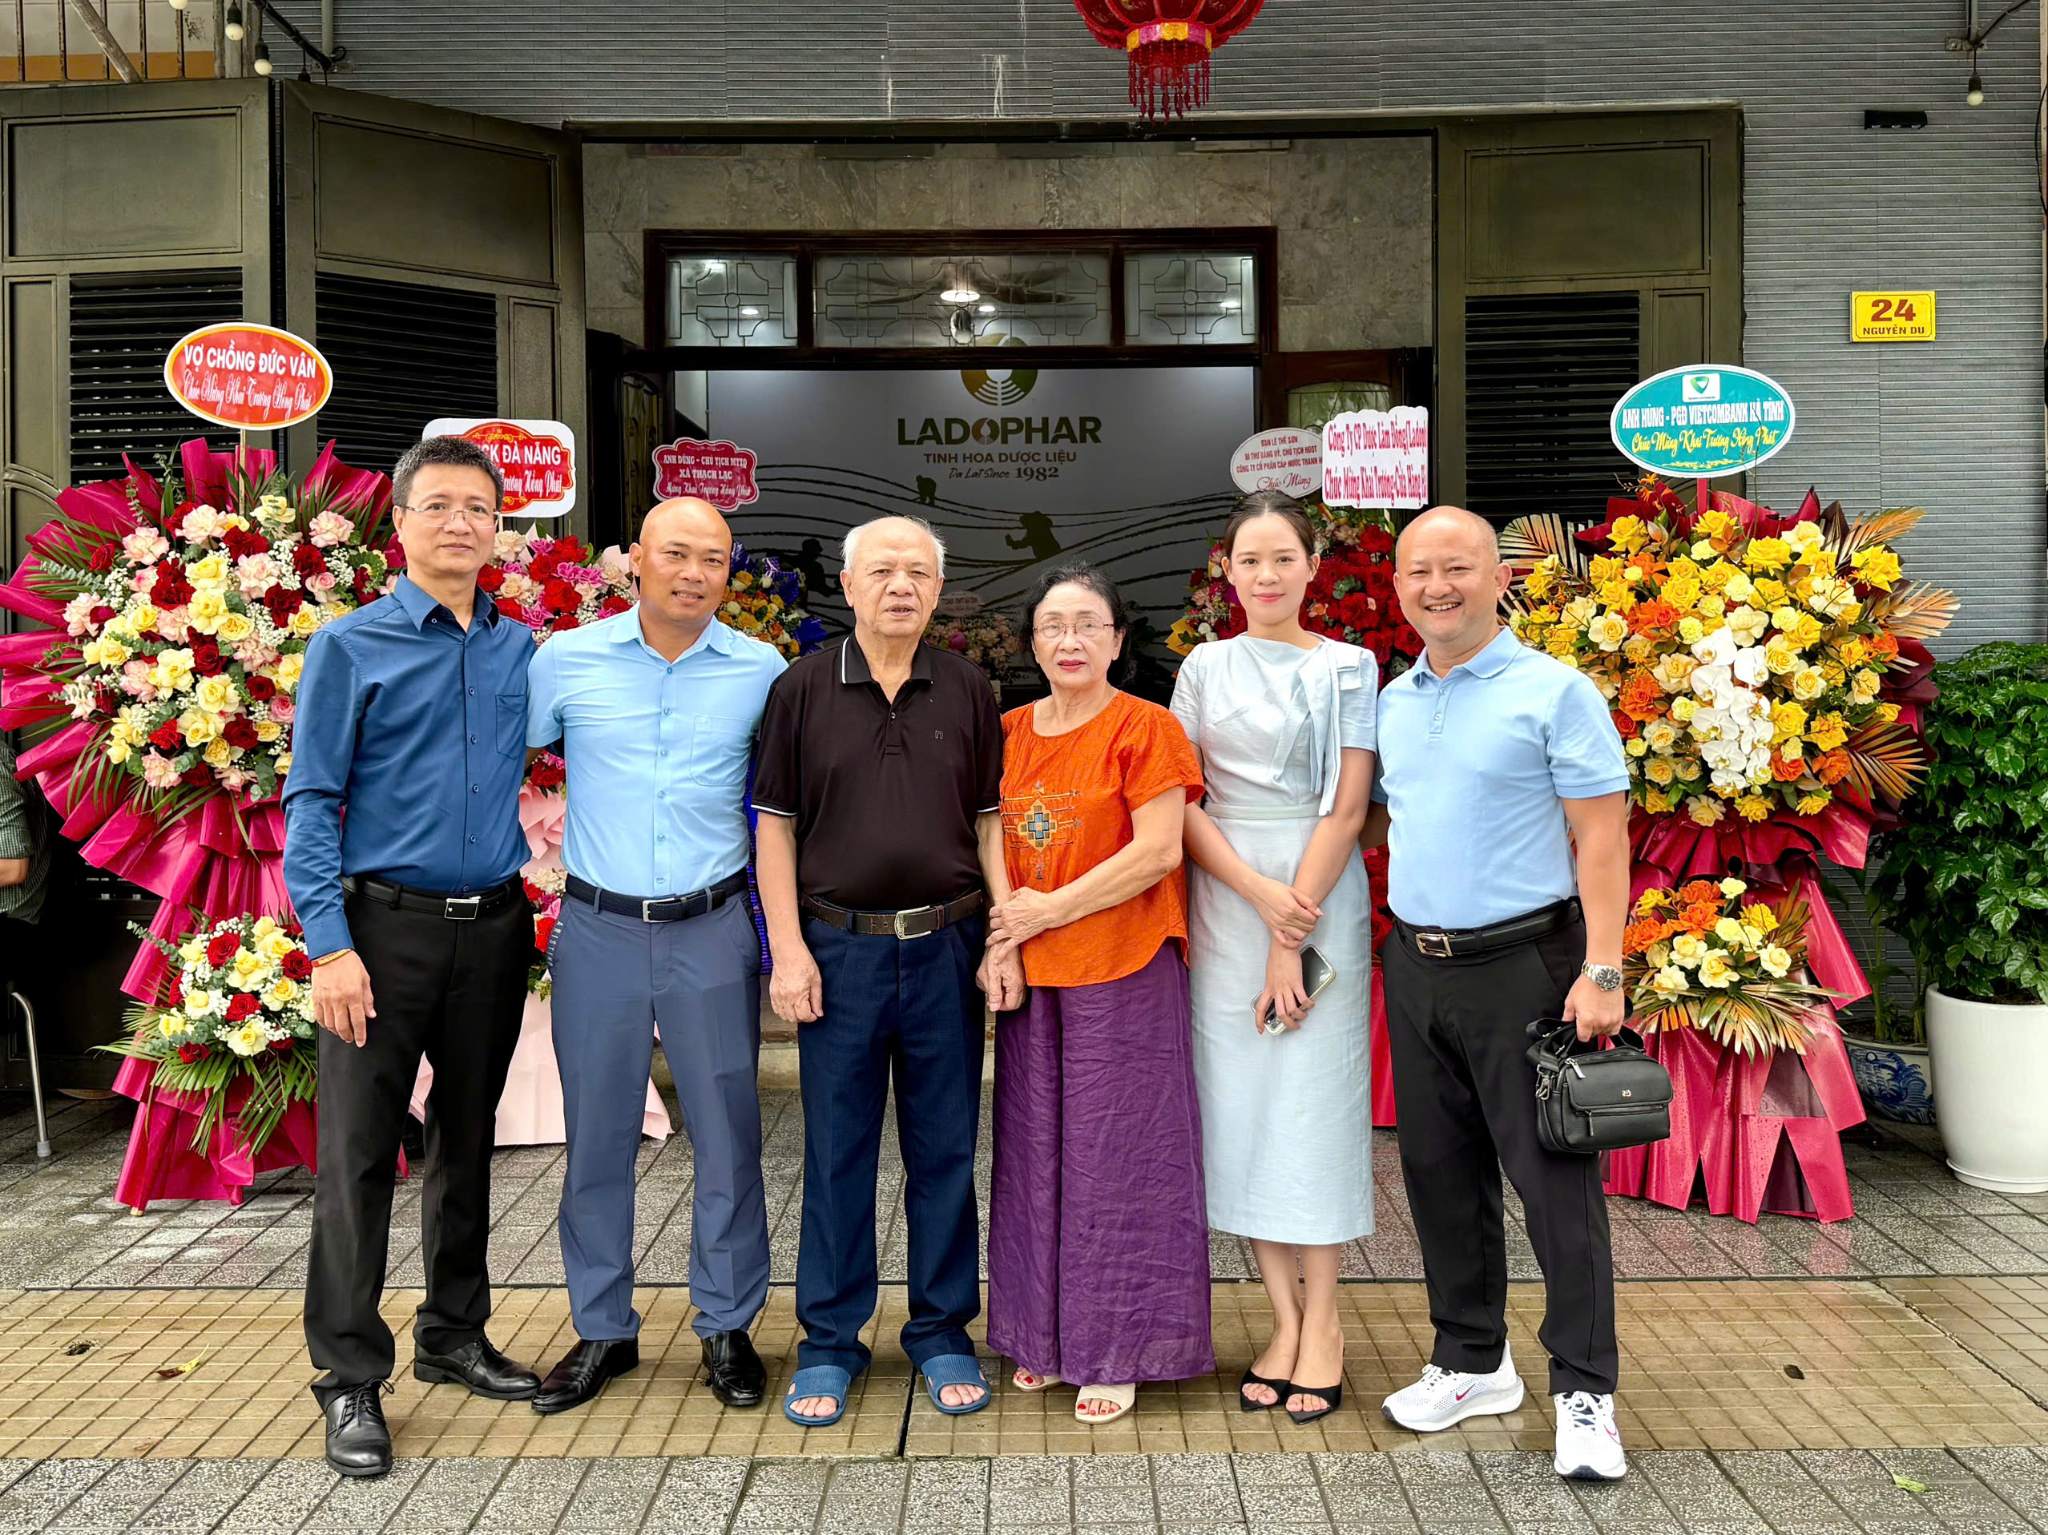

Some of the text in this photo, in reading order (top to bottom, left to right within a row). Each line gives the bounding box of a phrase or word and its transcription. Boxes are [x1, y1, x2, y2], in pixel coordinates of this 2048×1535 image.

[1871, 299, 1916, 322] 24
[1910, 326, 1925, 334] DU
[184, 339, 316, 378] VỢ CHỒNG ĐỨC VÂN
[1622, 408, 1640, 429] ANH
[1689, 402, 1748, 426] VIETCOMBANK
[897, 416, 1103, 446] LADOPHAR
[502, 441, 521, 464] ĐÀ
[923, 450, 1077, 466] TINH HOA DƯỢC LIỆU
[1015, 466, 1060, 482] 1982
